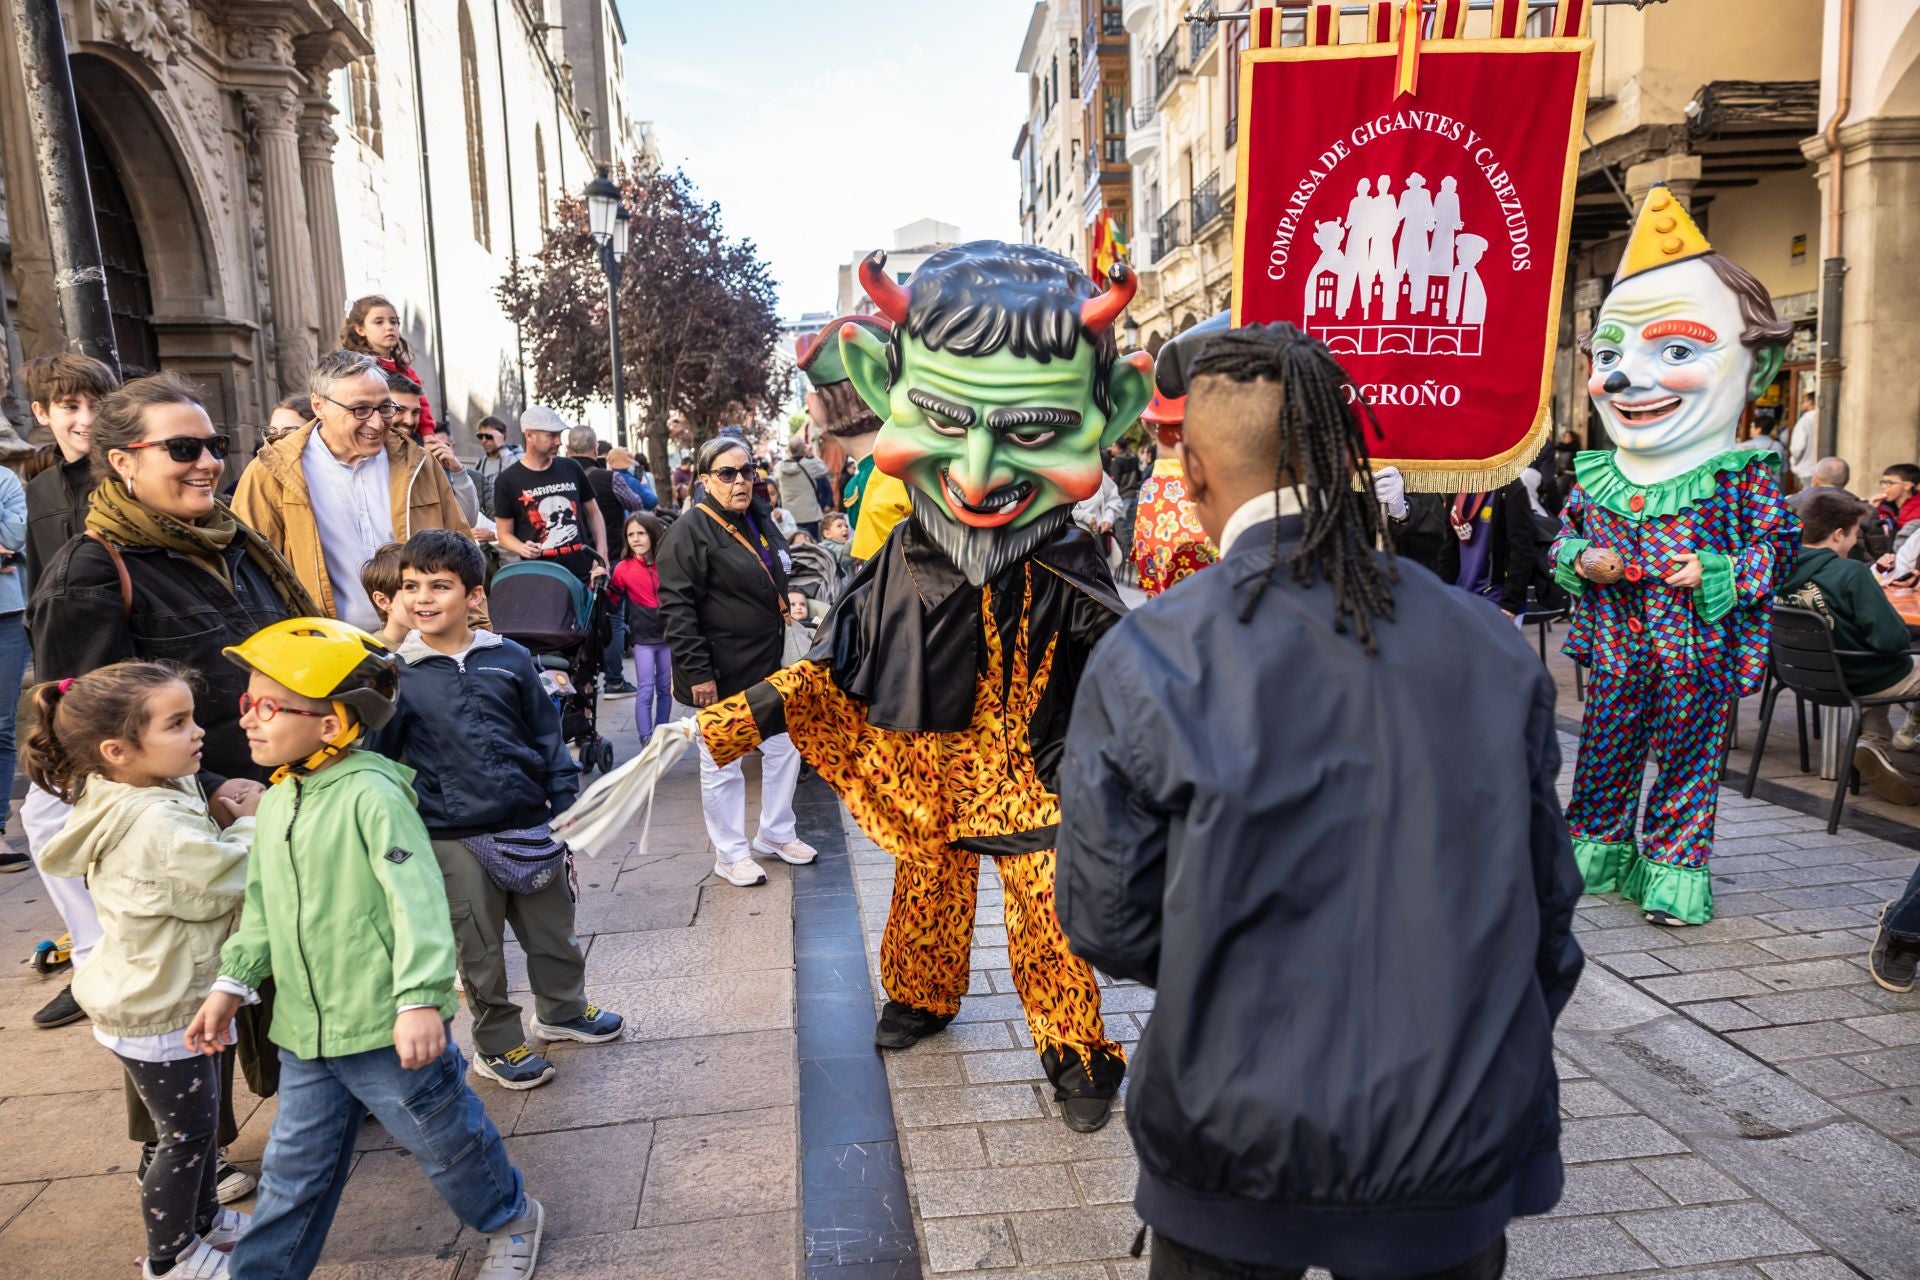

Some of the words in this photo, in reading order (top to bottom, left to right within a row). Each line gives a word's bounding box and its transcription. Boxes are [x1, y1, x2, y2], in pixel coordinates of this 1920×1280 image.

[1267, 168, 1327, 280] COMPARSA
[1318, 139, 1351, 171] DE
[1351, 110, 1465, 147] GIGANTES
[1463, 129, 1482, 151] Y
[1474, 147, 1531, 272] CABEZUDOS
[1339, 379, 1461, 407] OGROÑO
